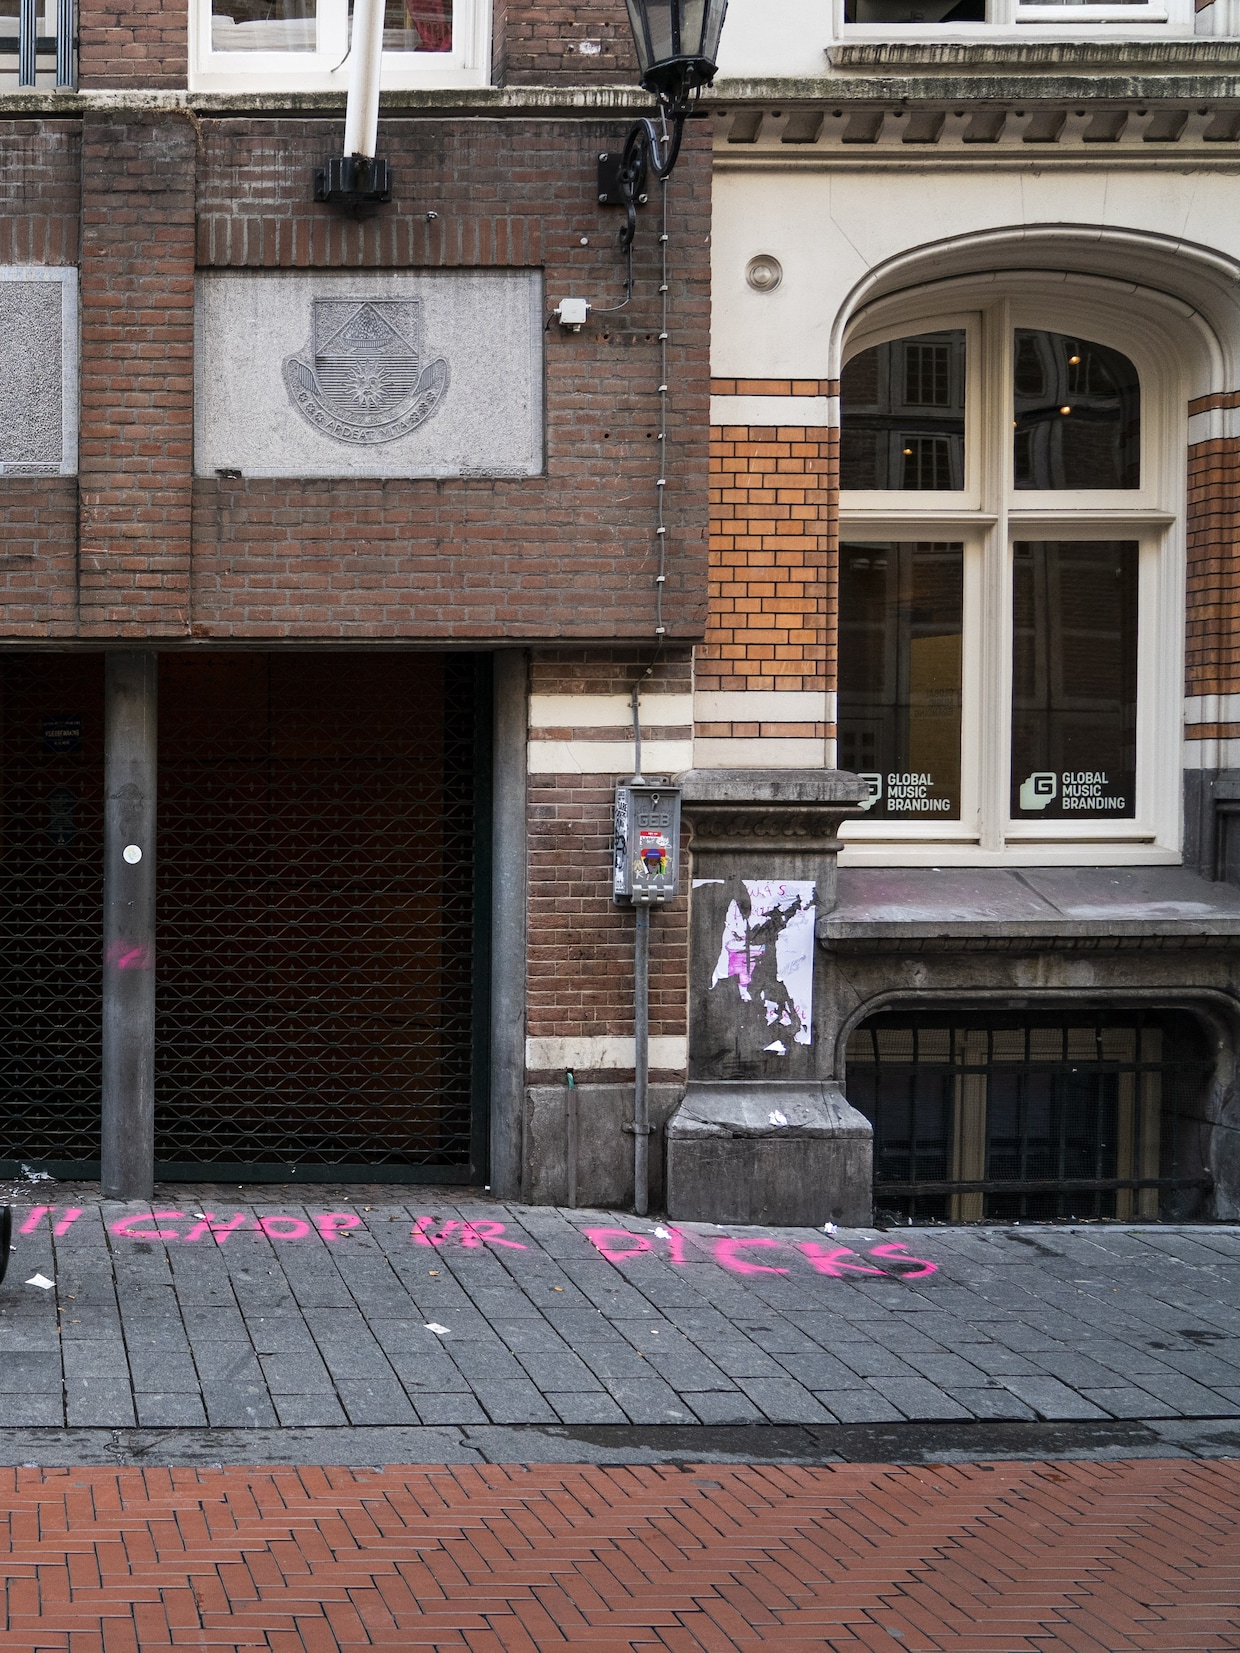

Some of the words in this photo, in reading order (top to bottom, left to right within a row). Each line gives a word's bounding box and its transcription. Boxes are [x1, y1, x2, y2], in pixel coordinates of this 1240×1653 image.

[887, 773, 934, 786] GLOBAL
[1062, 771, 1109, 785] GLOBAL
[887, 785, 927, 799] MUSIC
[1062, 784, 1102, 797] MUSIC
[887, 798, 950, 811] BRANDING
[1062, 797, 1125, 810] BRANDING
[638, 812, 670, 828] GEB
[110, 1210, 362, 1244] CHOP
[584, 1226, 940, 1280] DICKS
